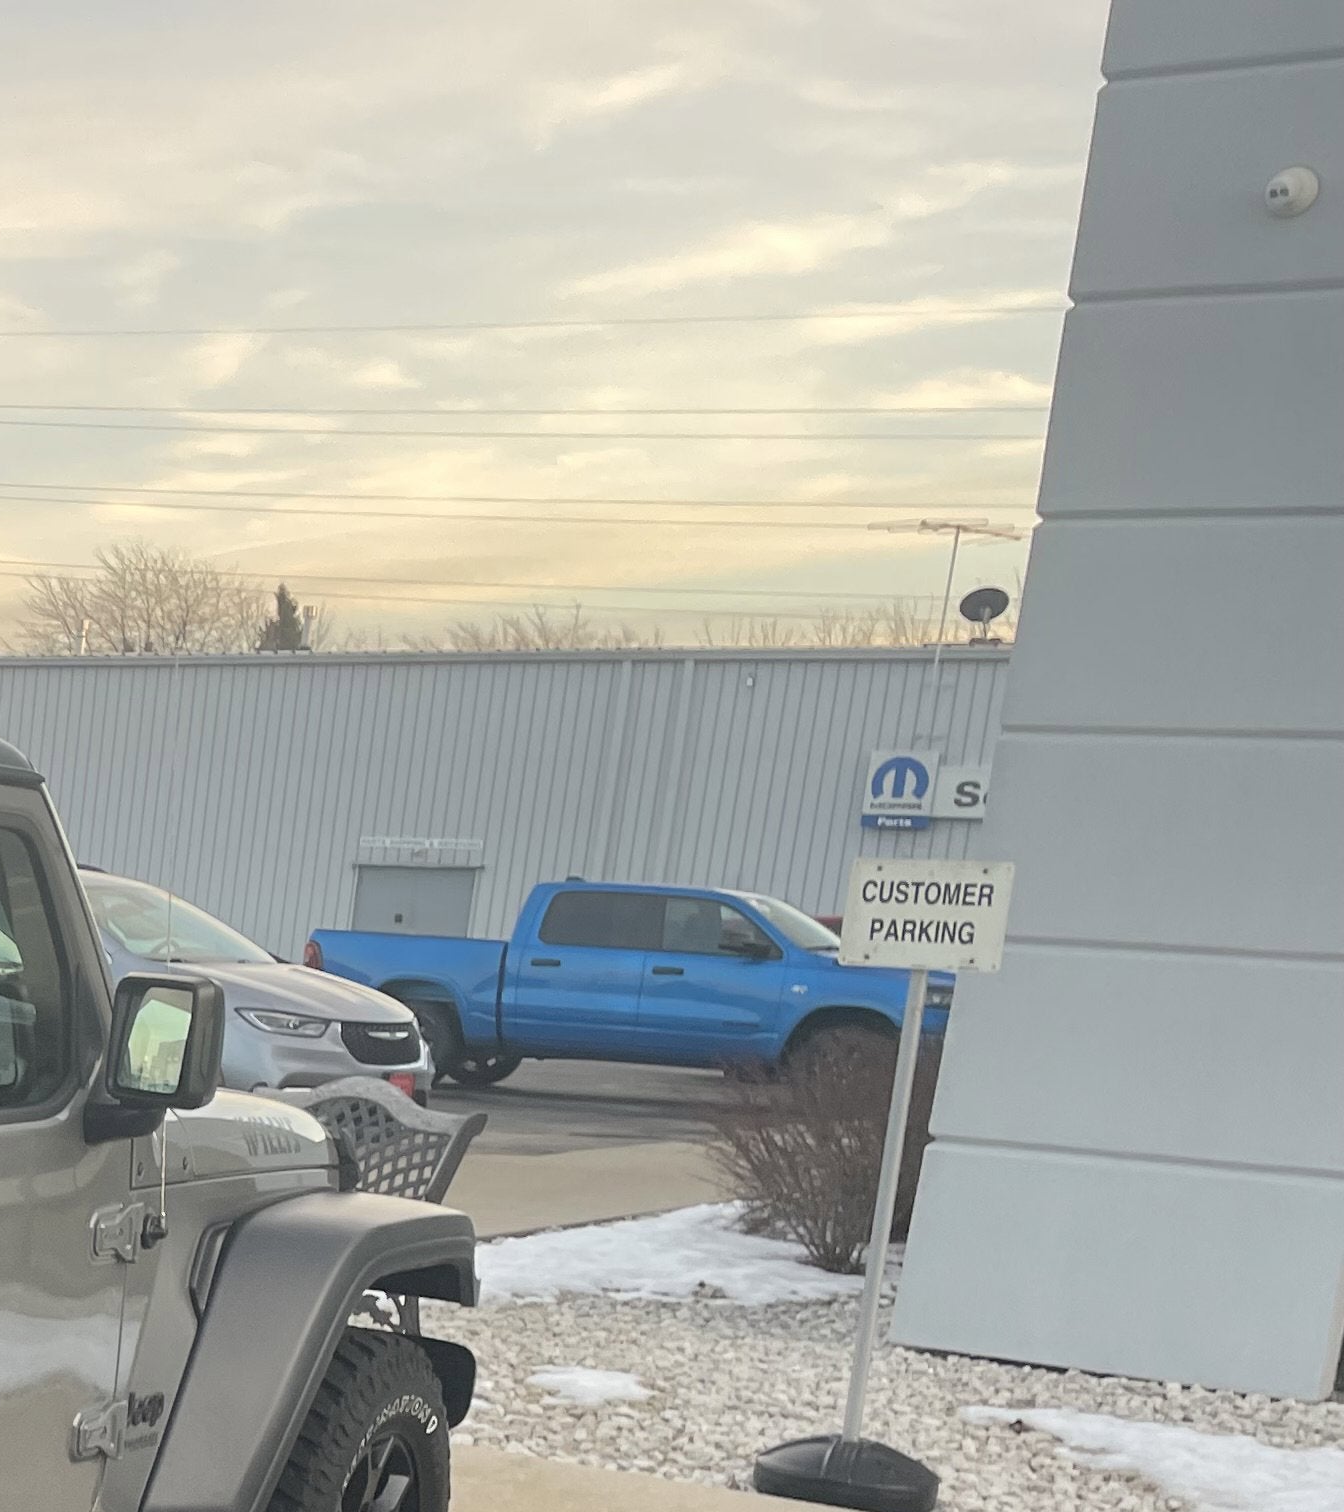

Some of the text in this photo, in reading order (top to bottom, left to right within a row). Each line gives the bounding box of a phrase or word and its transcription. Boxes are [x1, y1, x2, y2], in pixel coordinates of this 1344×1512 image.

[953, 780, 988, 808] S
[862, 879, 995, 907] CUSTOMER
[869, 917, 976, 945] PARKING
